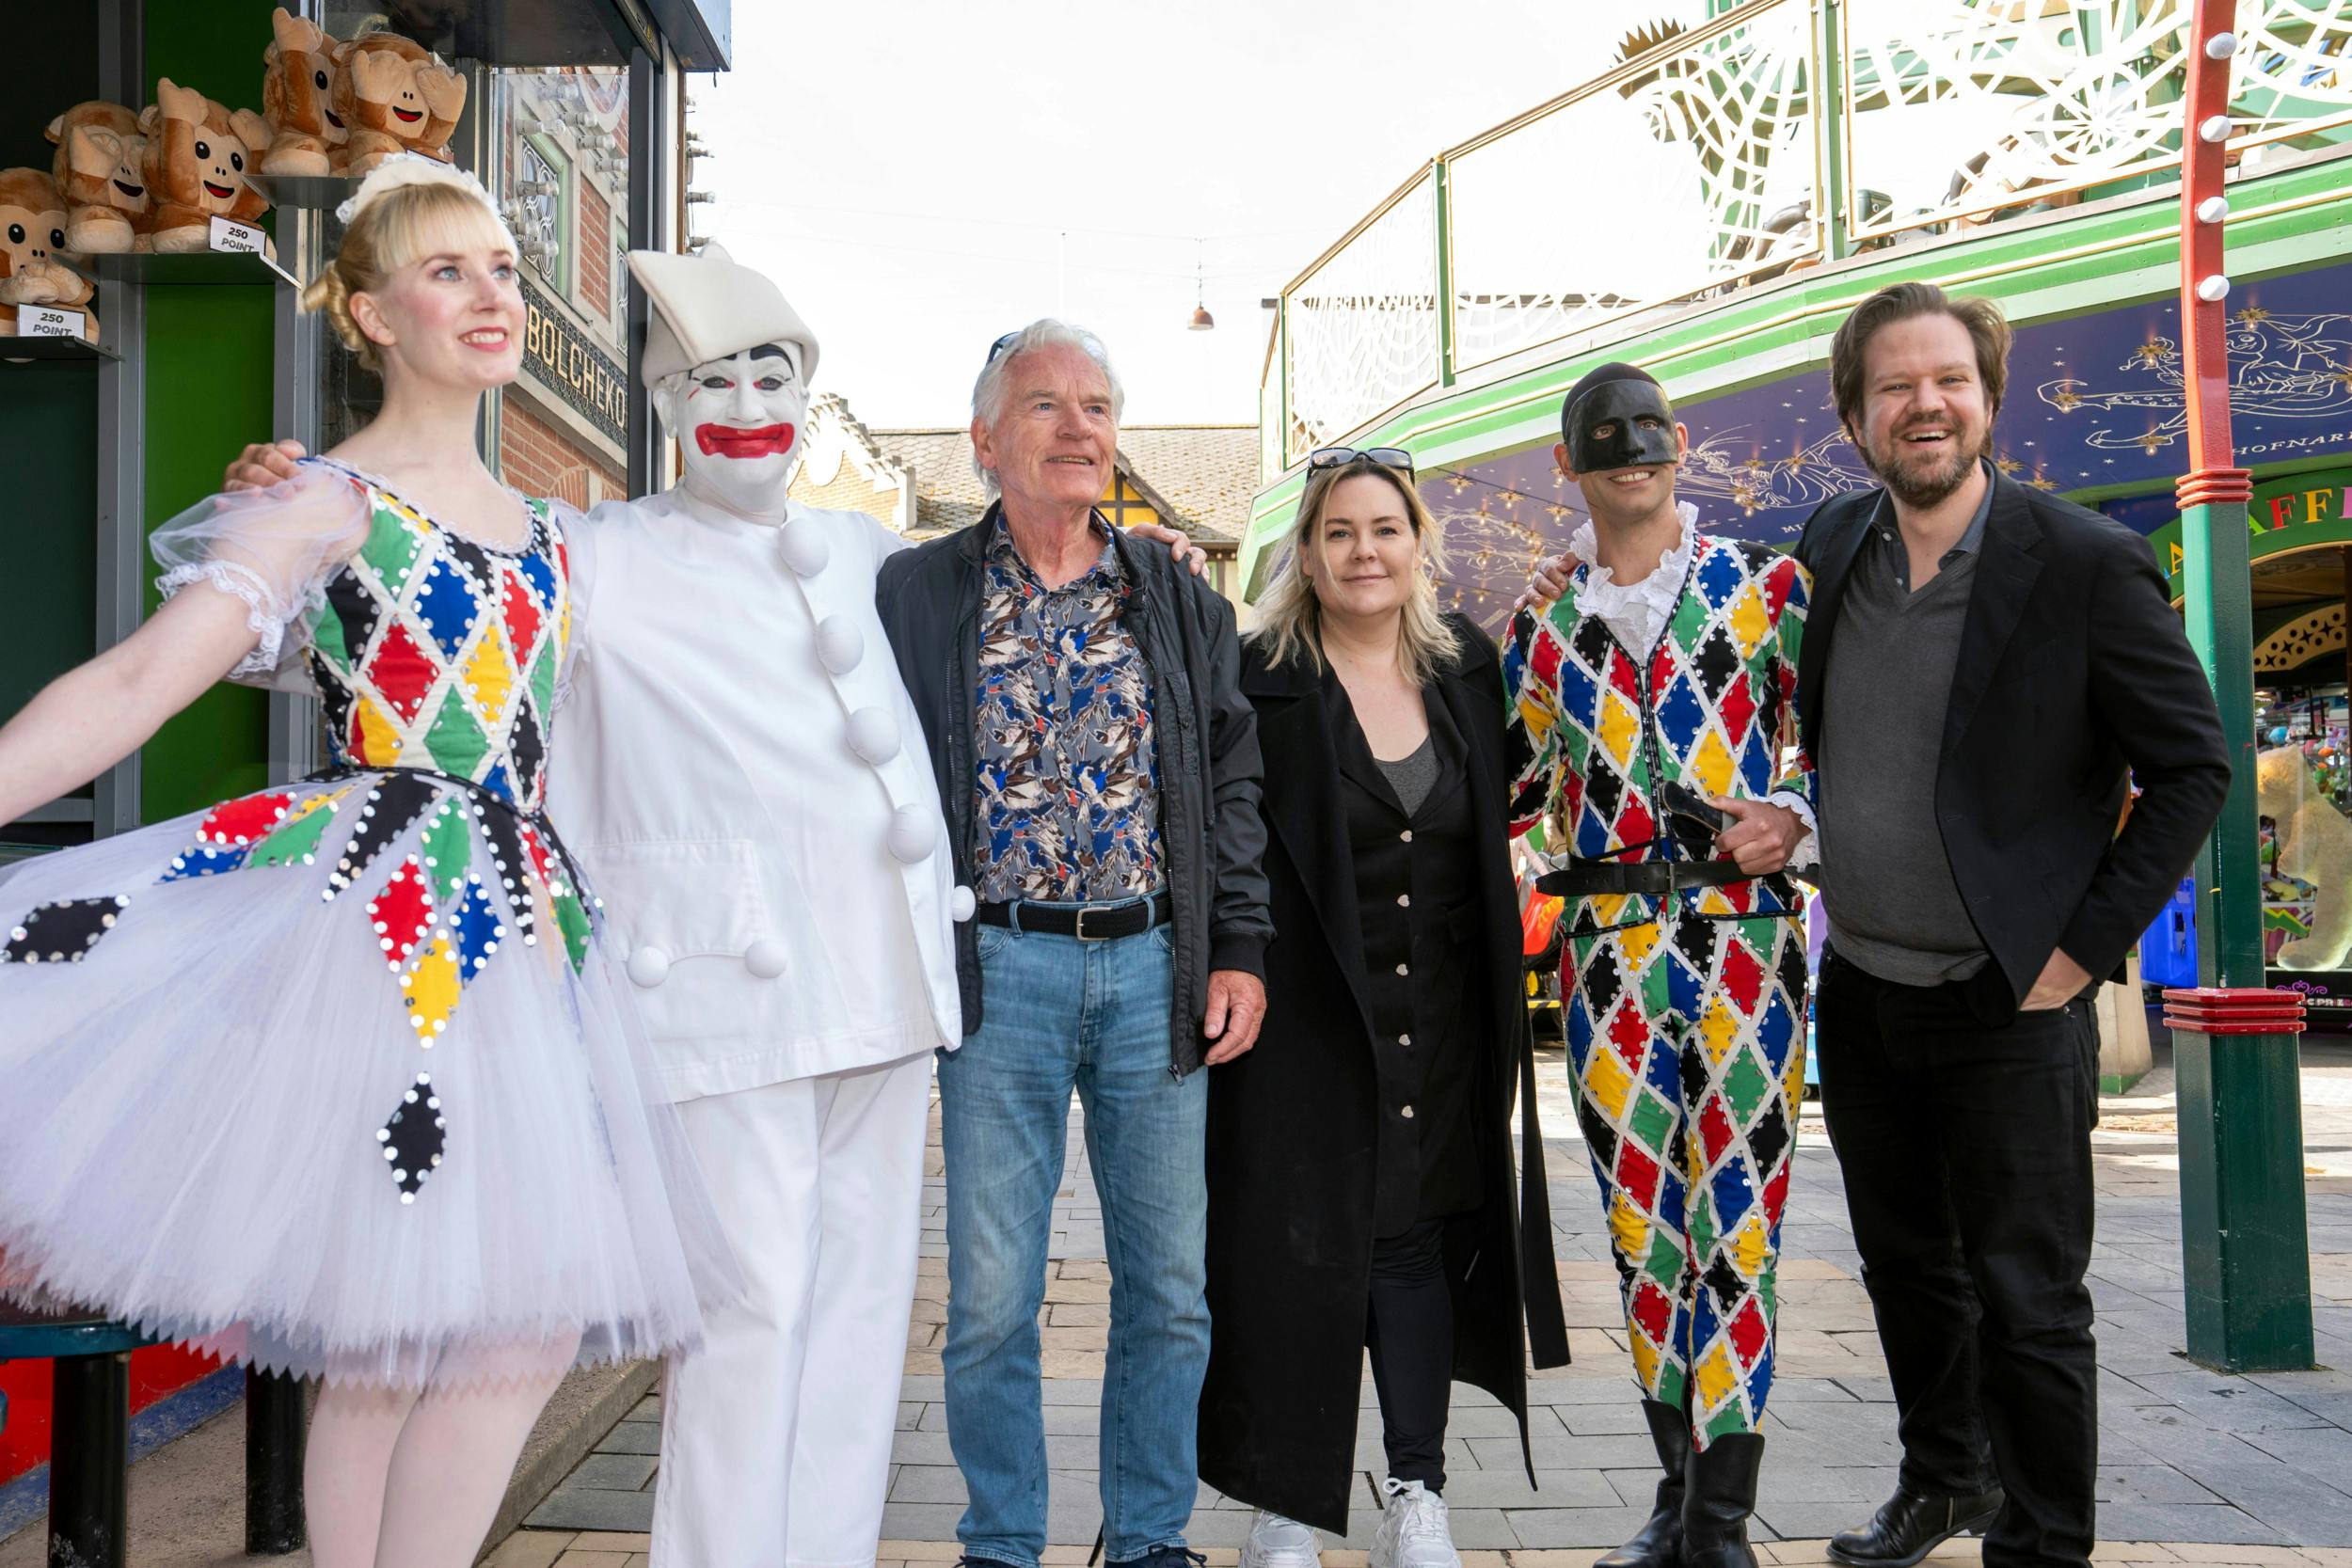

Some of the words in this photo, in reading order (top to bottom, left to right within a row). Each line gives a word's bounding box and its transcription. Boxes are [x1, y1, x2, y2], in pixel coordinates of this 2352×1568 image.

[228, 227, 248, 240] 250
[221, 237, 255, 252] POINT
[40, 312, 64, 324] 250
[33, 324, 72, 336] POINT
[527, 303, 626, 429] BOLCHEKO
